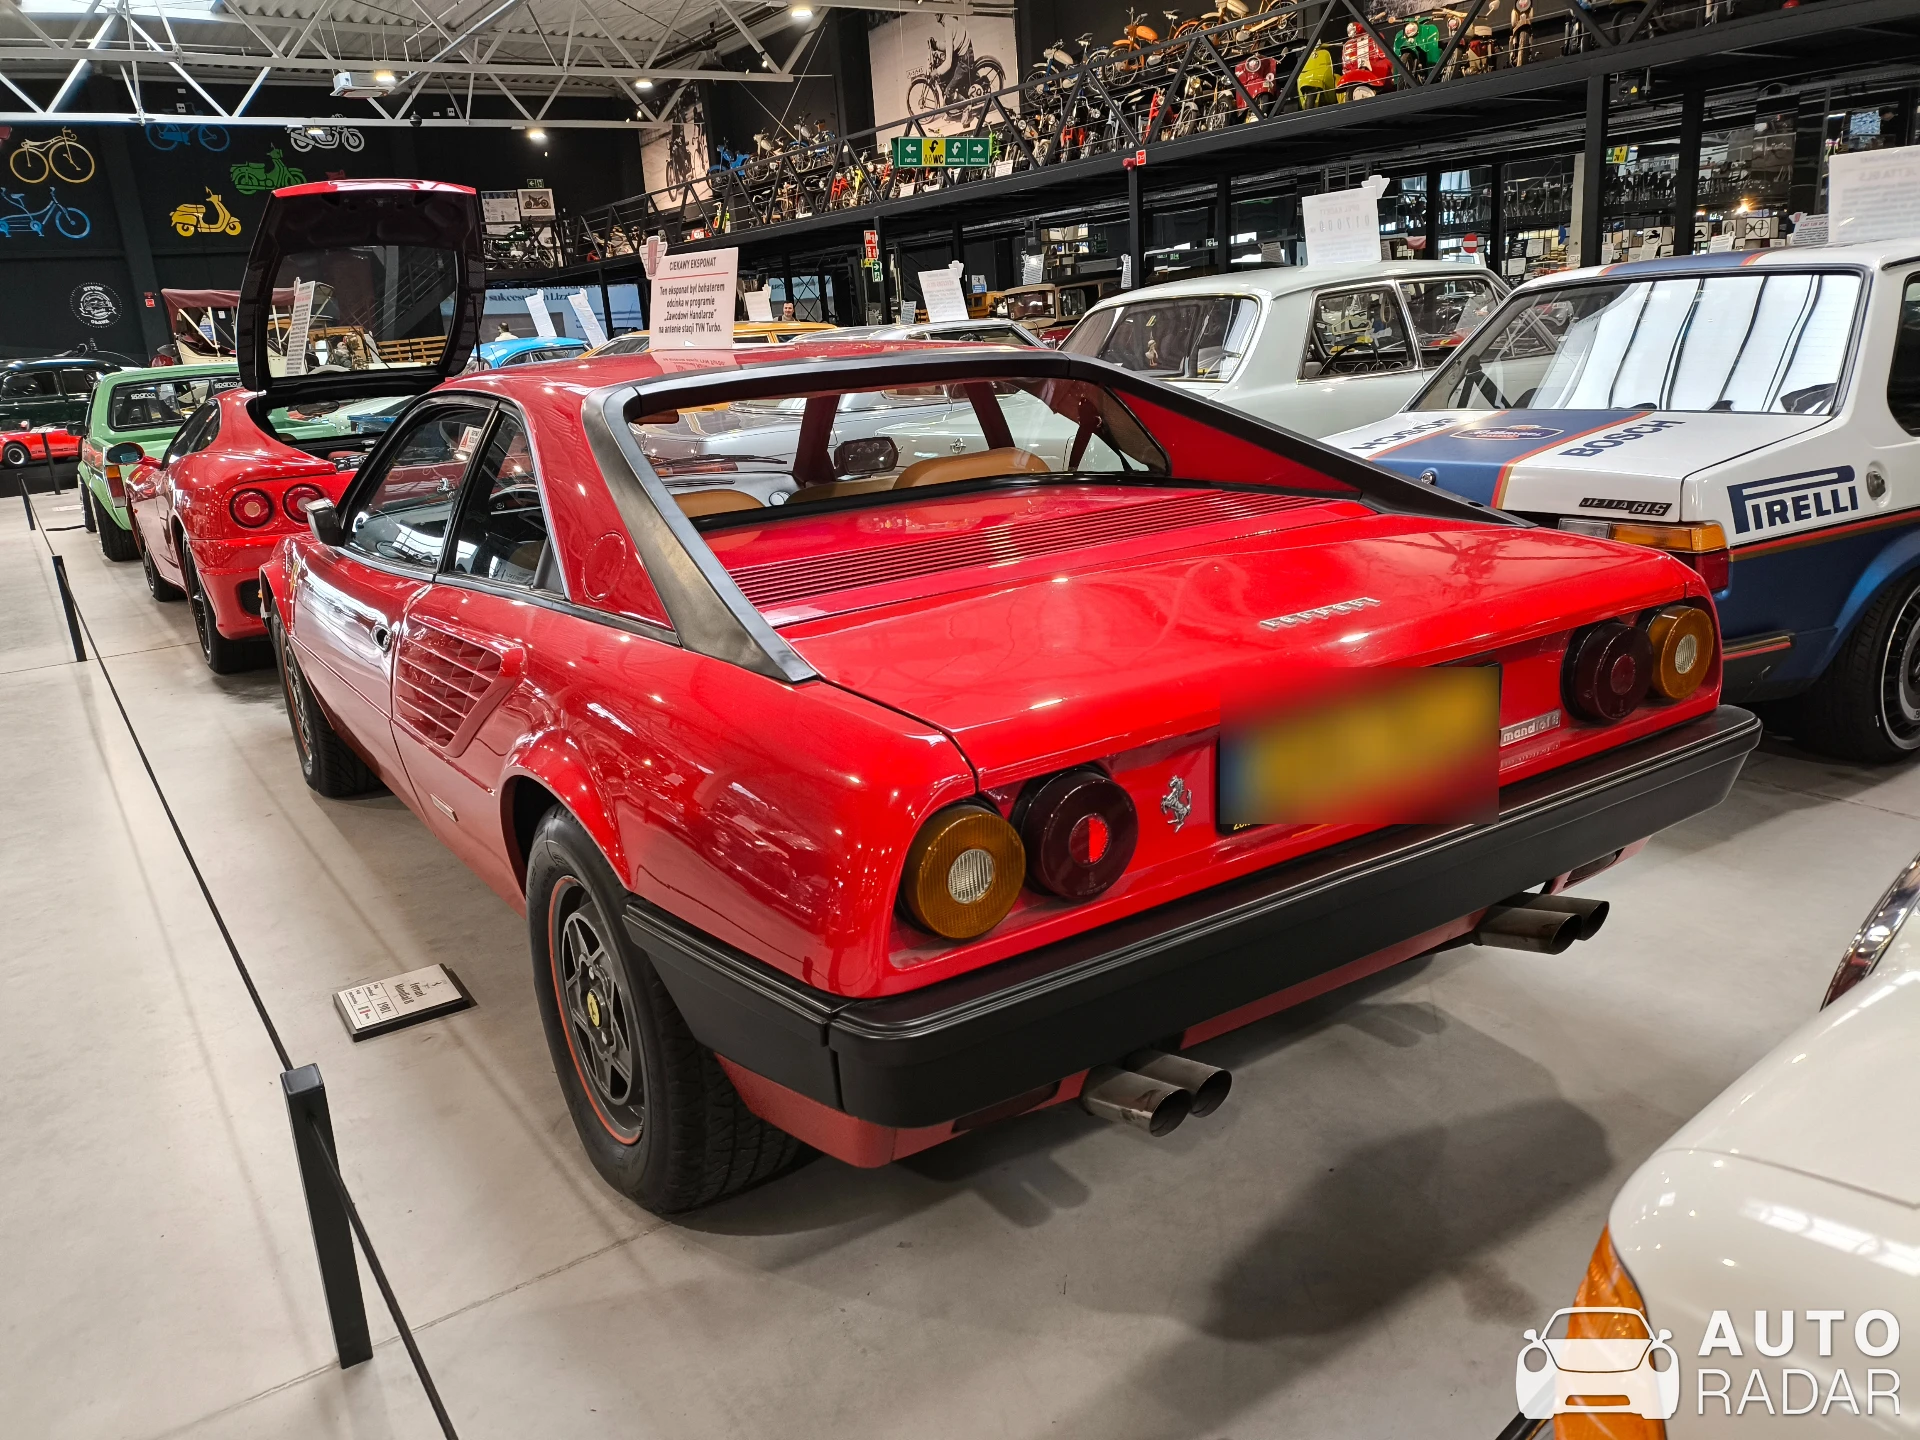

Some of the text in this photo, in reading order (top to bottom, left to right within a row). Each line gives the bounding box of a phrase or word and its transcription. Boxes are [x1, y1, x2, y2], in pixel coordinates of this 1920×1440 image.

[933, 154, 944, 164] WC
[669, 257, 717, 271] CIEKAWY EKSPONAT
[660, 283, 725, 296] Ten eksponat był bohaterem
[666, 299, 684, 308] odcinka
[689, 296, 715, 308] programie
[664, 325, 681, 333] antenie
[681, 324, 695, 334] stacji
[695, 323, 706, 333] TVN
[706, 323, 722, 332] Turbo.
[214, 381, 243, 389] sparco
[131, 392, 156, 400] sparco
[1558, 419, 1687, 457] BOSCH
[1726, 464, 1859, 535] PIRELLI
[1580, 497, 1668, 516] JETTA GLS
